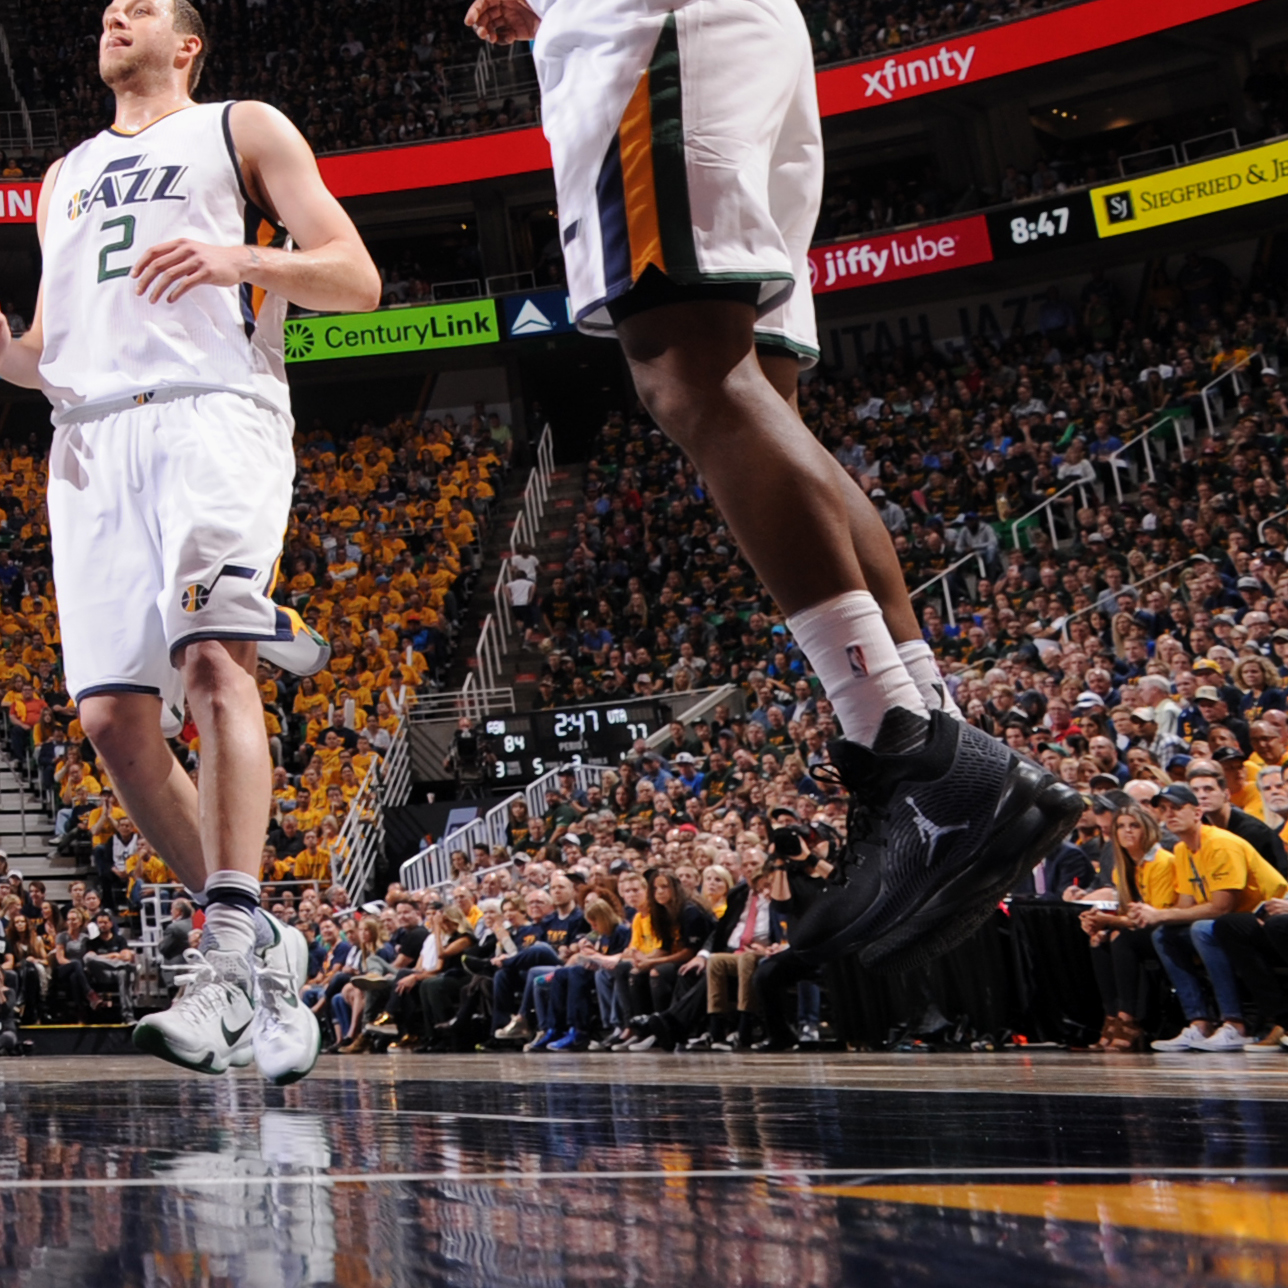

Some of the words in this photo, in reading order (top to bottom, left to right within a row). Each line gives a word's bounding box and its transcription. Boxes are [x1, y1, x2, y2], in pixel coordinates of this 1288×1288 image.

[862, 45, 976, 100] xfinity
[67, 153, 190, 221] JAZZ
[1140, 173, 1242, 212] SIEGFRIED
[1246, 164, 1269, 185] &
[1010, 206, 1070, 244] 8:47
[96, 213, 136, 284] 2
[324, 312, 491, 349] CenturyLink
[504, 735, 525, 753] 84
[627, 723, 648, 740] 77
[555, 709, 599, 737] 2:47
[495, 761, 506, 778] 3
[532, 757, 544, 775] 5
